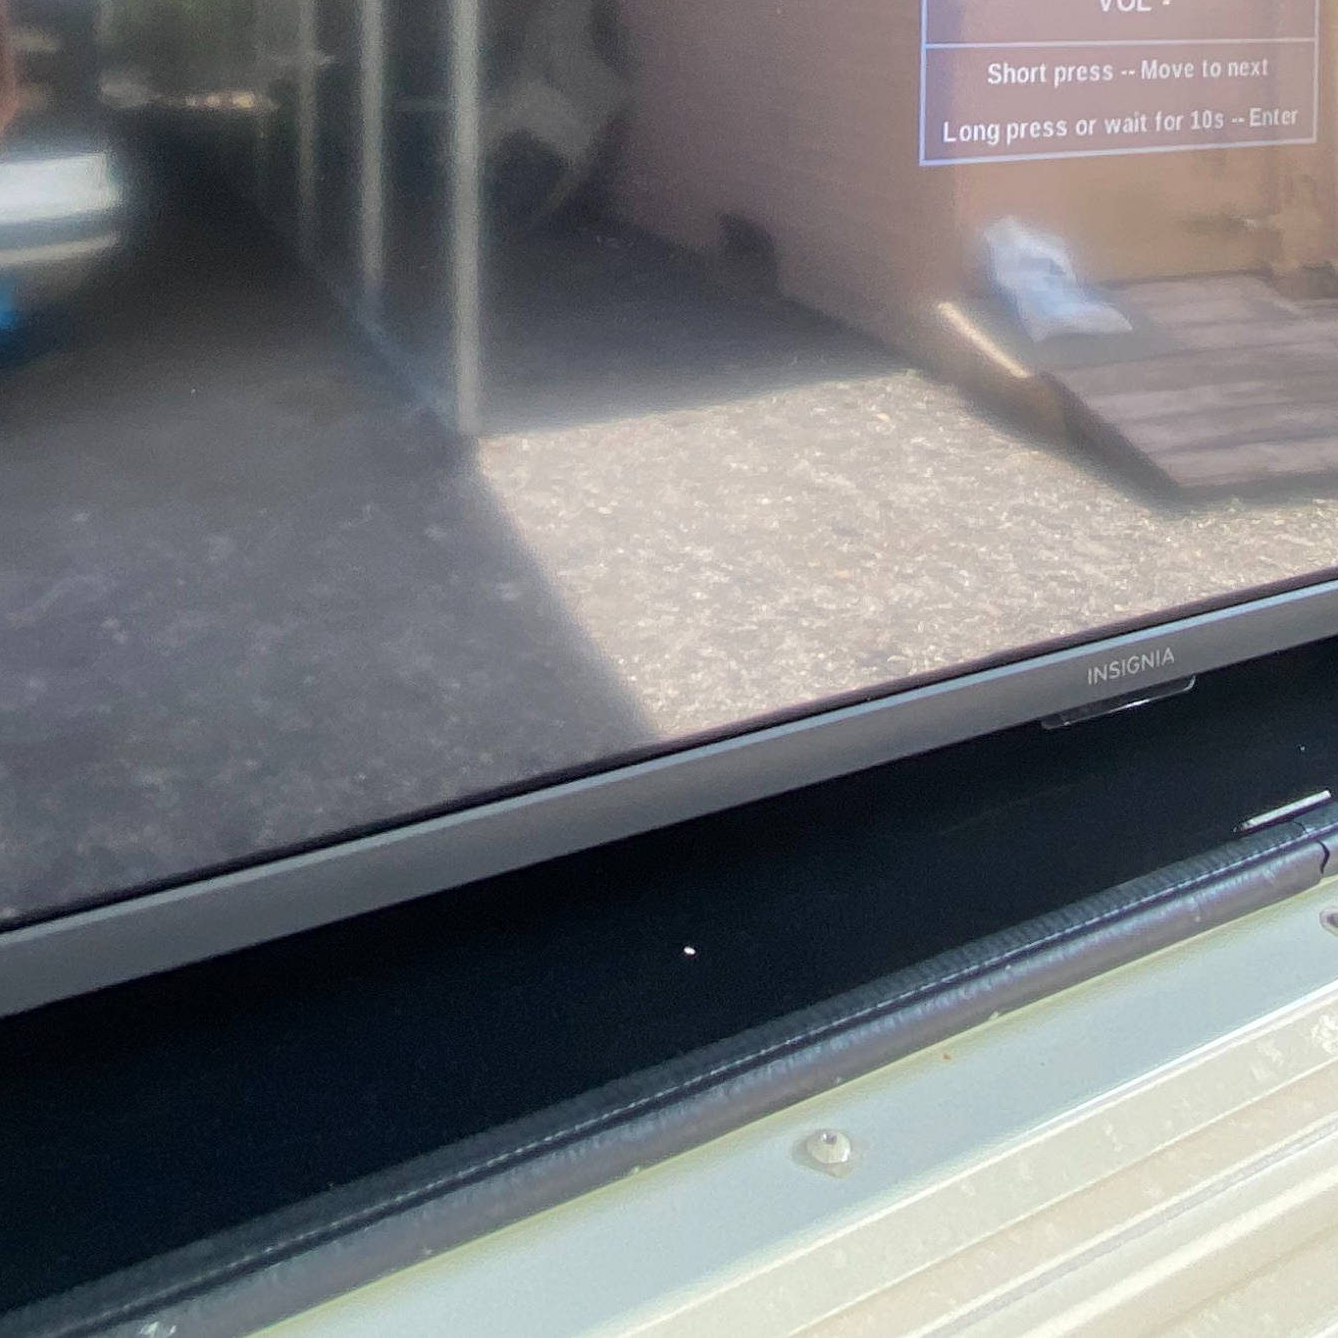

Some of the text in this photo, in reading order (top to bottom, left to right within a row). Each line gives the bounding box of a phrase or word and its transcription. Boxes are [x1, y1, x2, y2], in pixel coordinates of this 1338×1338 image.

[987, 61, 1047, 85] Short
[1053, 64, 1114, 89] press
[1140, 58, 1195, 80] Move
[1201, 59, 1223, 79] to
[1227, 58, 1269, 77] next
[943, 121, 1001, 147] Long
[1006, 119, 1068, 146] press
[1075, 118, 1097, 137] or
[1103, 111, 1148, 135] wait
[1154, 110, 1185, 133] for
[1190, 109, 1225, 130] 10s
[1249, 107, 1299, 128] Enter
[1087, 647, 1175, 685] INSIGNIA
